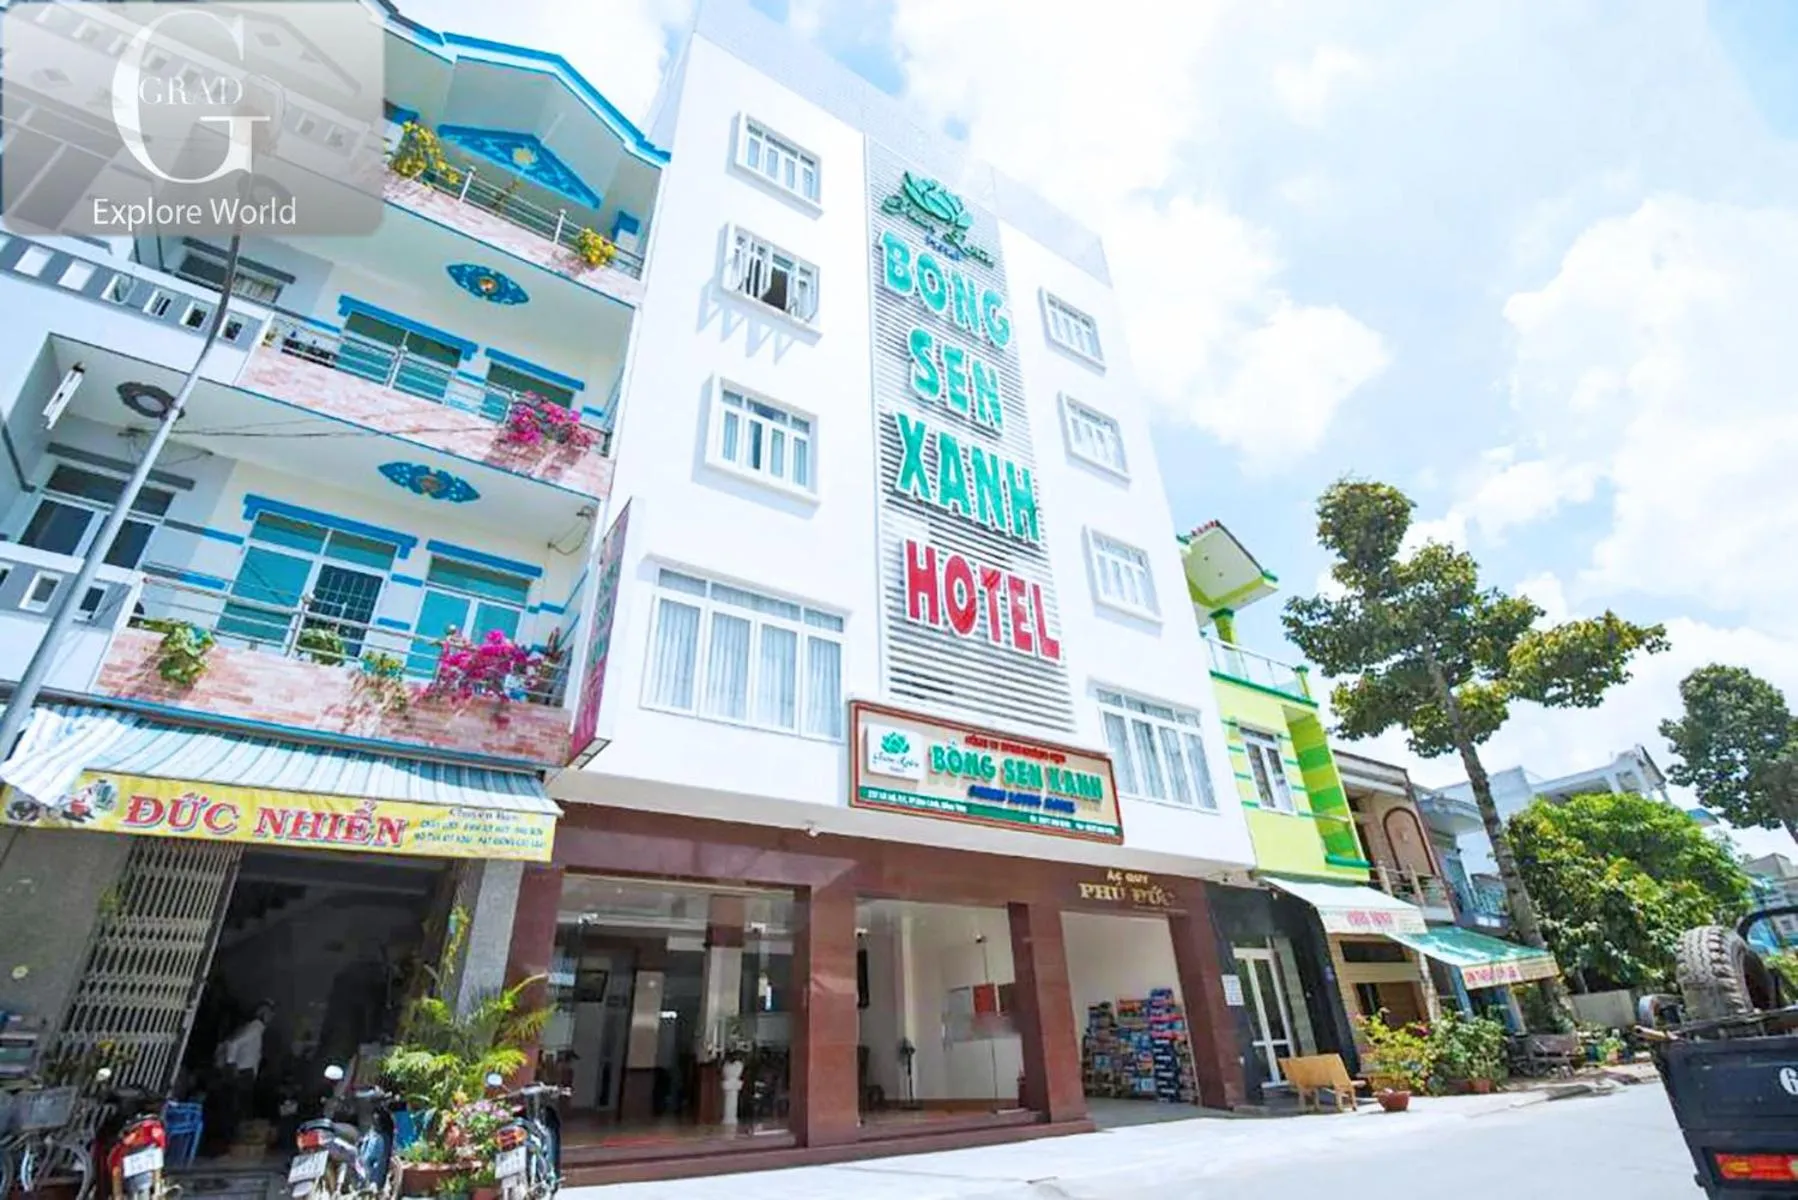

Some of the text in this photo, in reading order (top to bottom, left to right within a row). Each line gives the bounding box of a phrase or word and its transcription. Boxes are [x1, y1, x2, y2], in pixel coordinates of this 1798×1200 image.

[908, 327, 1004, 430] SEN
[895, 410, 1041, 543] XANH
[904, 537, 1061, 662] HOTEL
[122, 792, 240, 834] ĐỨC
[1002, 757, 1043, 790] SEN
[1043, 765, 1104, 802] XANH
